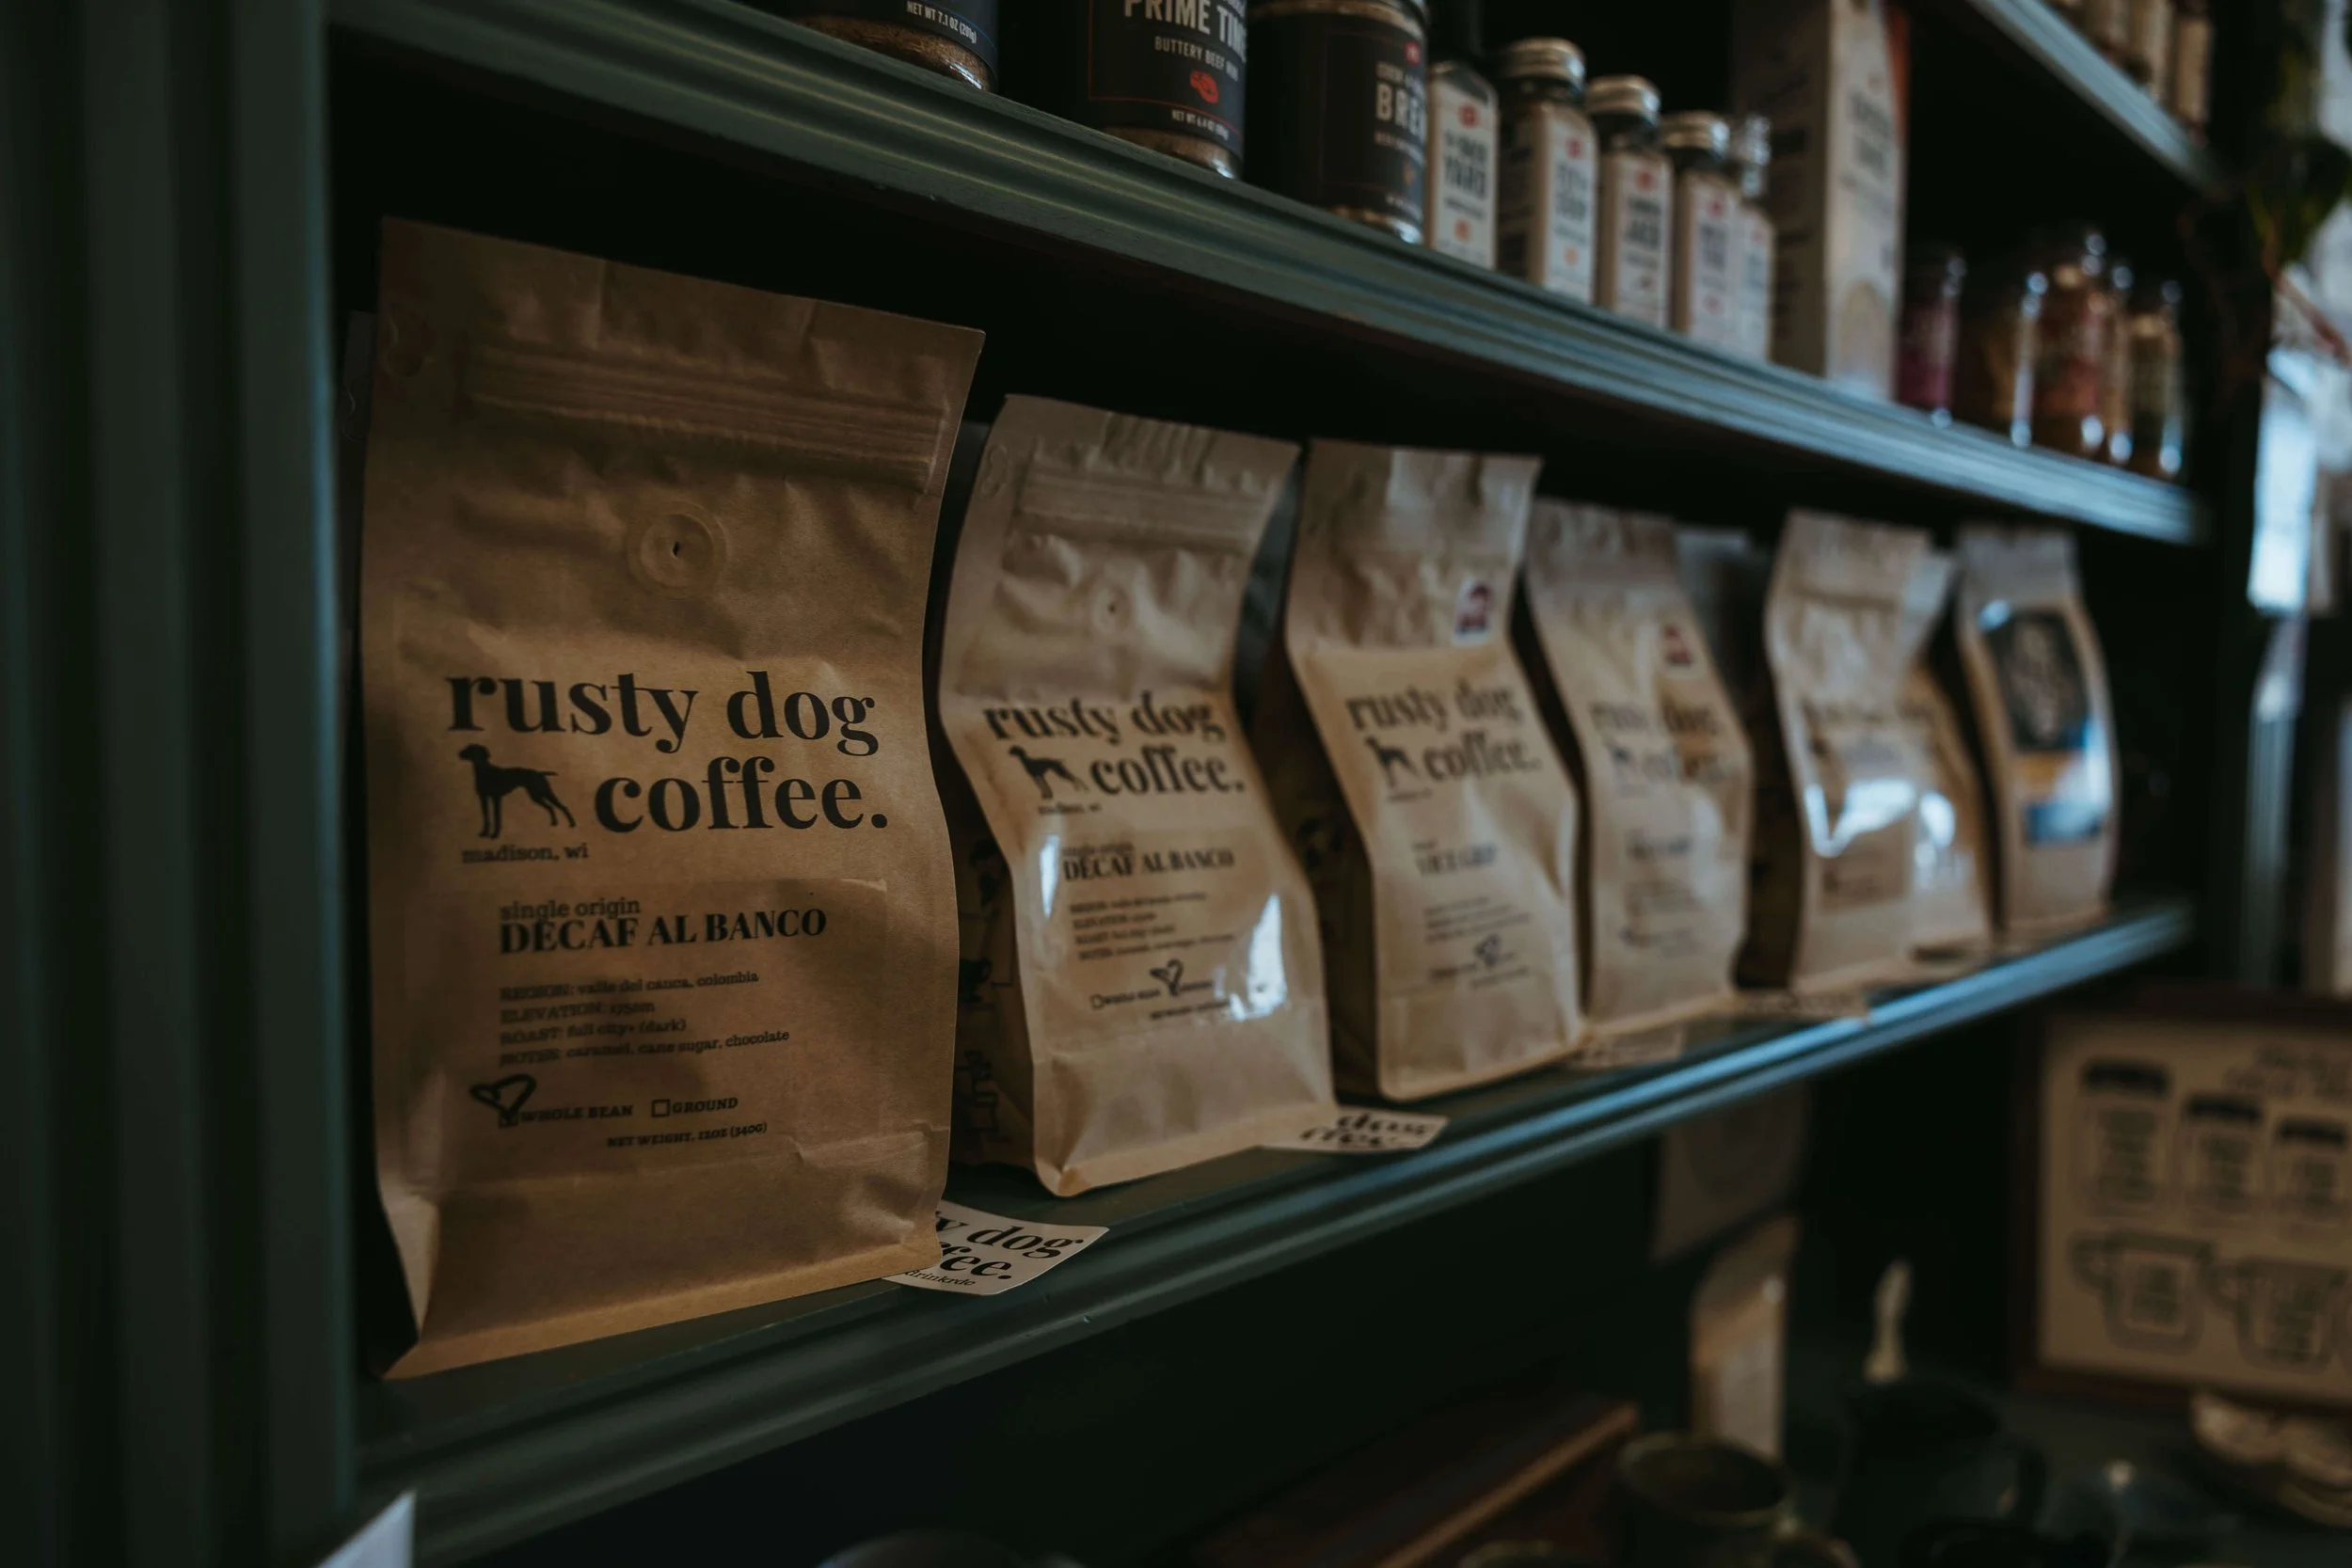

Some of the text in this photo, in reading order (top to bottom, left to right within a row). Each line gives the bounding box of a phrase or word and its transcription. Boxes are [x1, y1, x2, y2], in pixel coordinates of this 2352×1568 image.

[907, 1, 923, 16] NET
[925, 6, 936, 21] WT
[949, 16, 959, 32] OZ
[1154, 36, 1203, 61] BUTTERY
[445, 670, 880, 756] rusty dog
[983, 689, 1227, 747] rusty dog
[1089, 743, 1245, 796] coffee.
[594, 755, 888, 833] coffee.
[461, 842, 588, 863] madison, wi
[500, 897, 641, 921] single origin
[500, 909, 827, 955] DECAF AL BANCO
[619, 978, 644, 991] del
[697, 971, 759, 988] colombia
[639, 1019, 687, 1034] (dark)
[639, 1043, 675, 1054] cane
[725, 1030, 790, 1048] chocolate
[520, 1097, 739, 1123] WHOLE BEAN GROUND
[607, 1135, 634, 1148] NET
[966, 1226, 1085, 1259] dog
